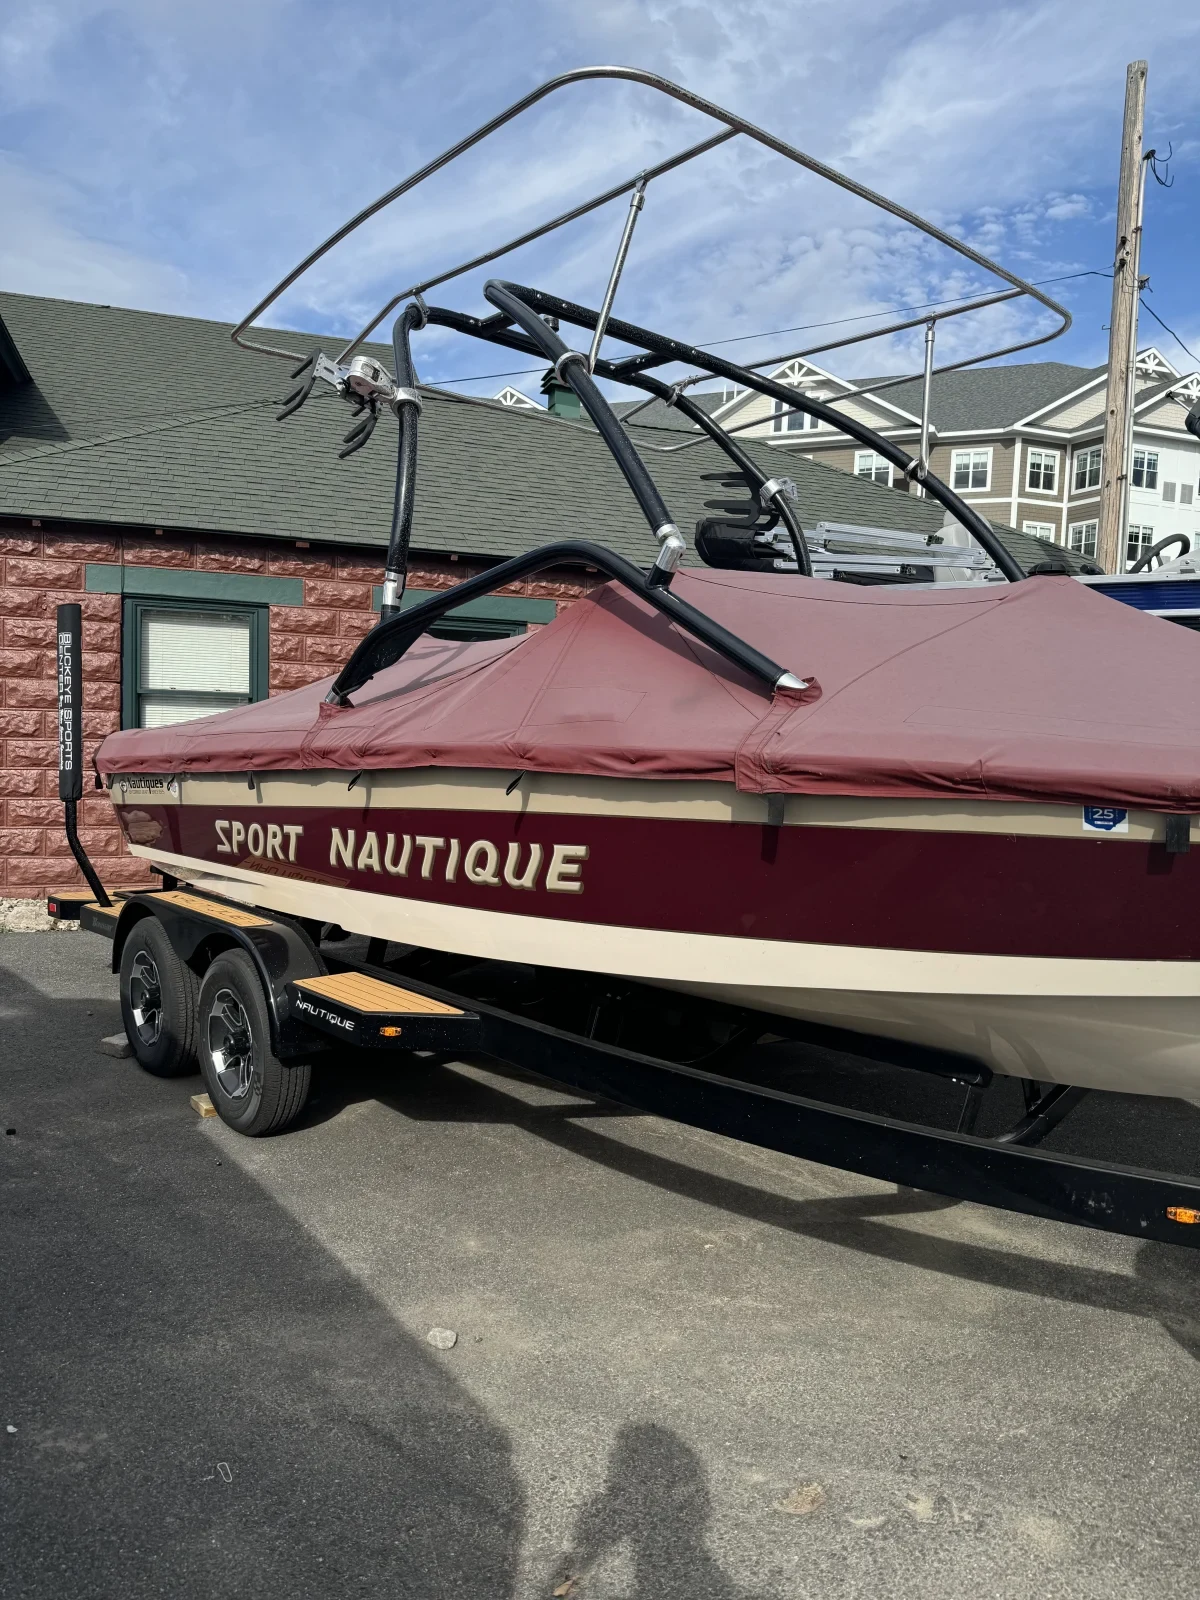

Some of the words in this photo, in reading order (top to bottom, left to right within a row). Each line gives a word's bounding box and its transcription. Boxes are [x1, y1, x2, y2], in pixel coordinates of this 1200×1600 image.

[63, 631, 72, 704] BUCKEYE
[63, 707, 73, 771] SPORTS
[127, 777, 164, 795] Nautiques
[1092, 808, 1114, 819] 25
[214, 819, 303, 864] SPORT
[329, 827, 589, 894] NAUTIQUE
[295, 999, 355, 1031] NAUTIQUE
